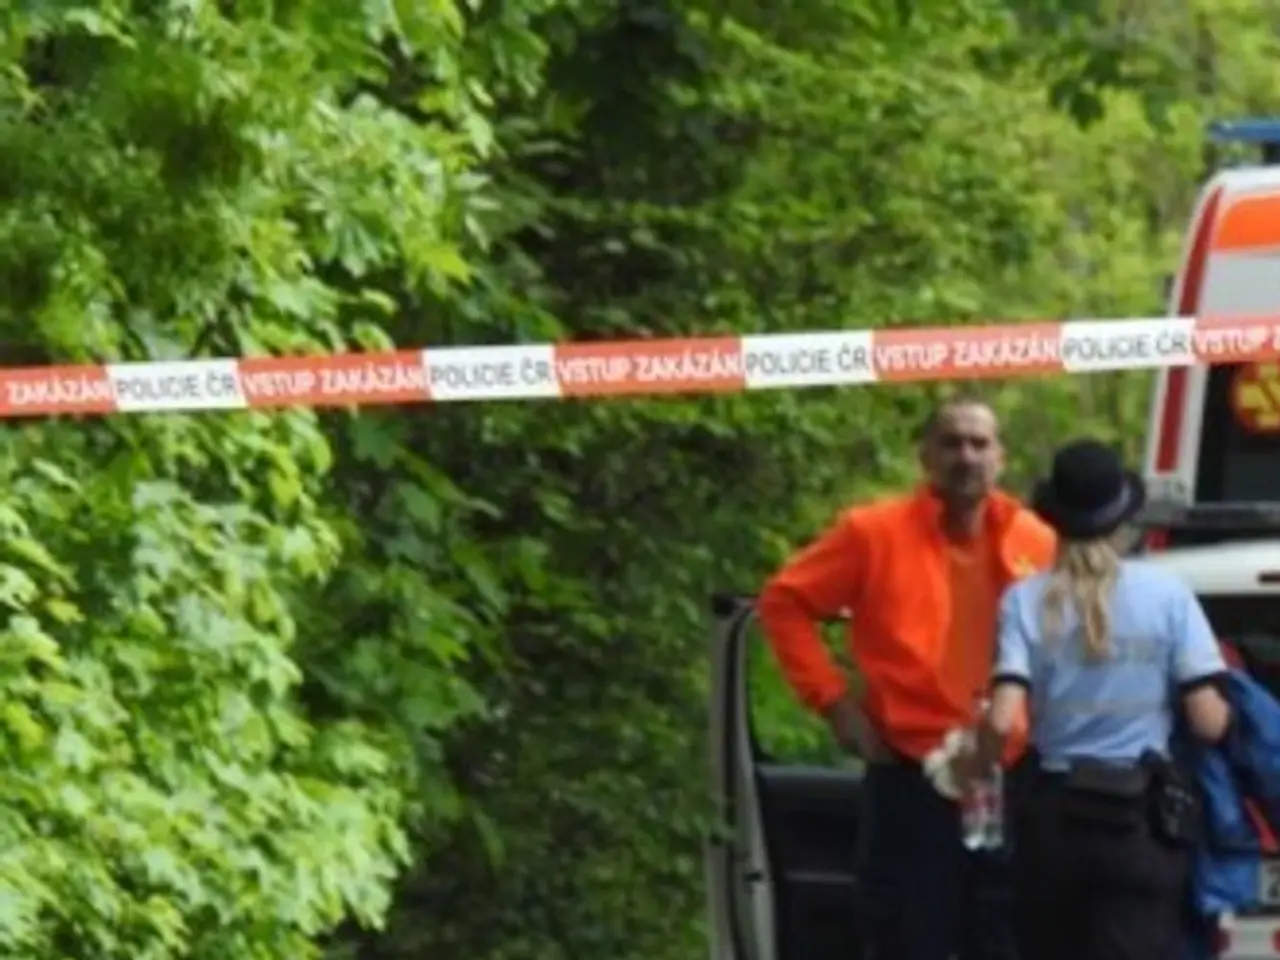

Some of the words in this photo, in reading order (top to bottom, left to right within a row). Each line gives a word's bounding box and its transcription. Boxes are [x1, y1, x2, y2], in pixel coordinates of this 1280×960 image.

[117, 374, 200, 402] POLICIE
[206, 369, 236, 399] ČR
[244, 370, 315, 398] VSTUP
[320, 363, 424, 394] ZAKÁZÁN
[431, 361, 513, 389] POLICIE
[520, 358, 552, 385] ČR
[557, 355, 632, 384] VSTUP
[637, 347, 741, 381] ZAKÁZÁN
[747, 346, 831, 376] POLICIE
[838, 343, 868, 370] ČR
[875, 341, 947, 370] VSTUP
[952, 336, 1058, 367] ZAKÁZÁN
[1063, 333, 1145, 362] POLICIE
[1154, 328, 1186, 358] ČR
[1193, 326, 1268, 356] VSTUP
